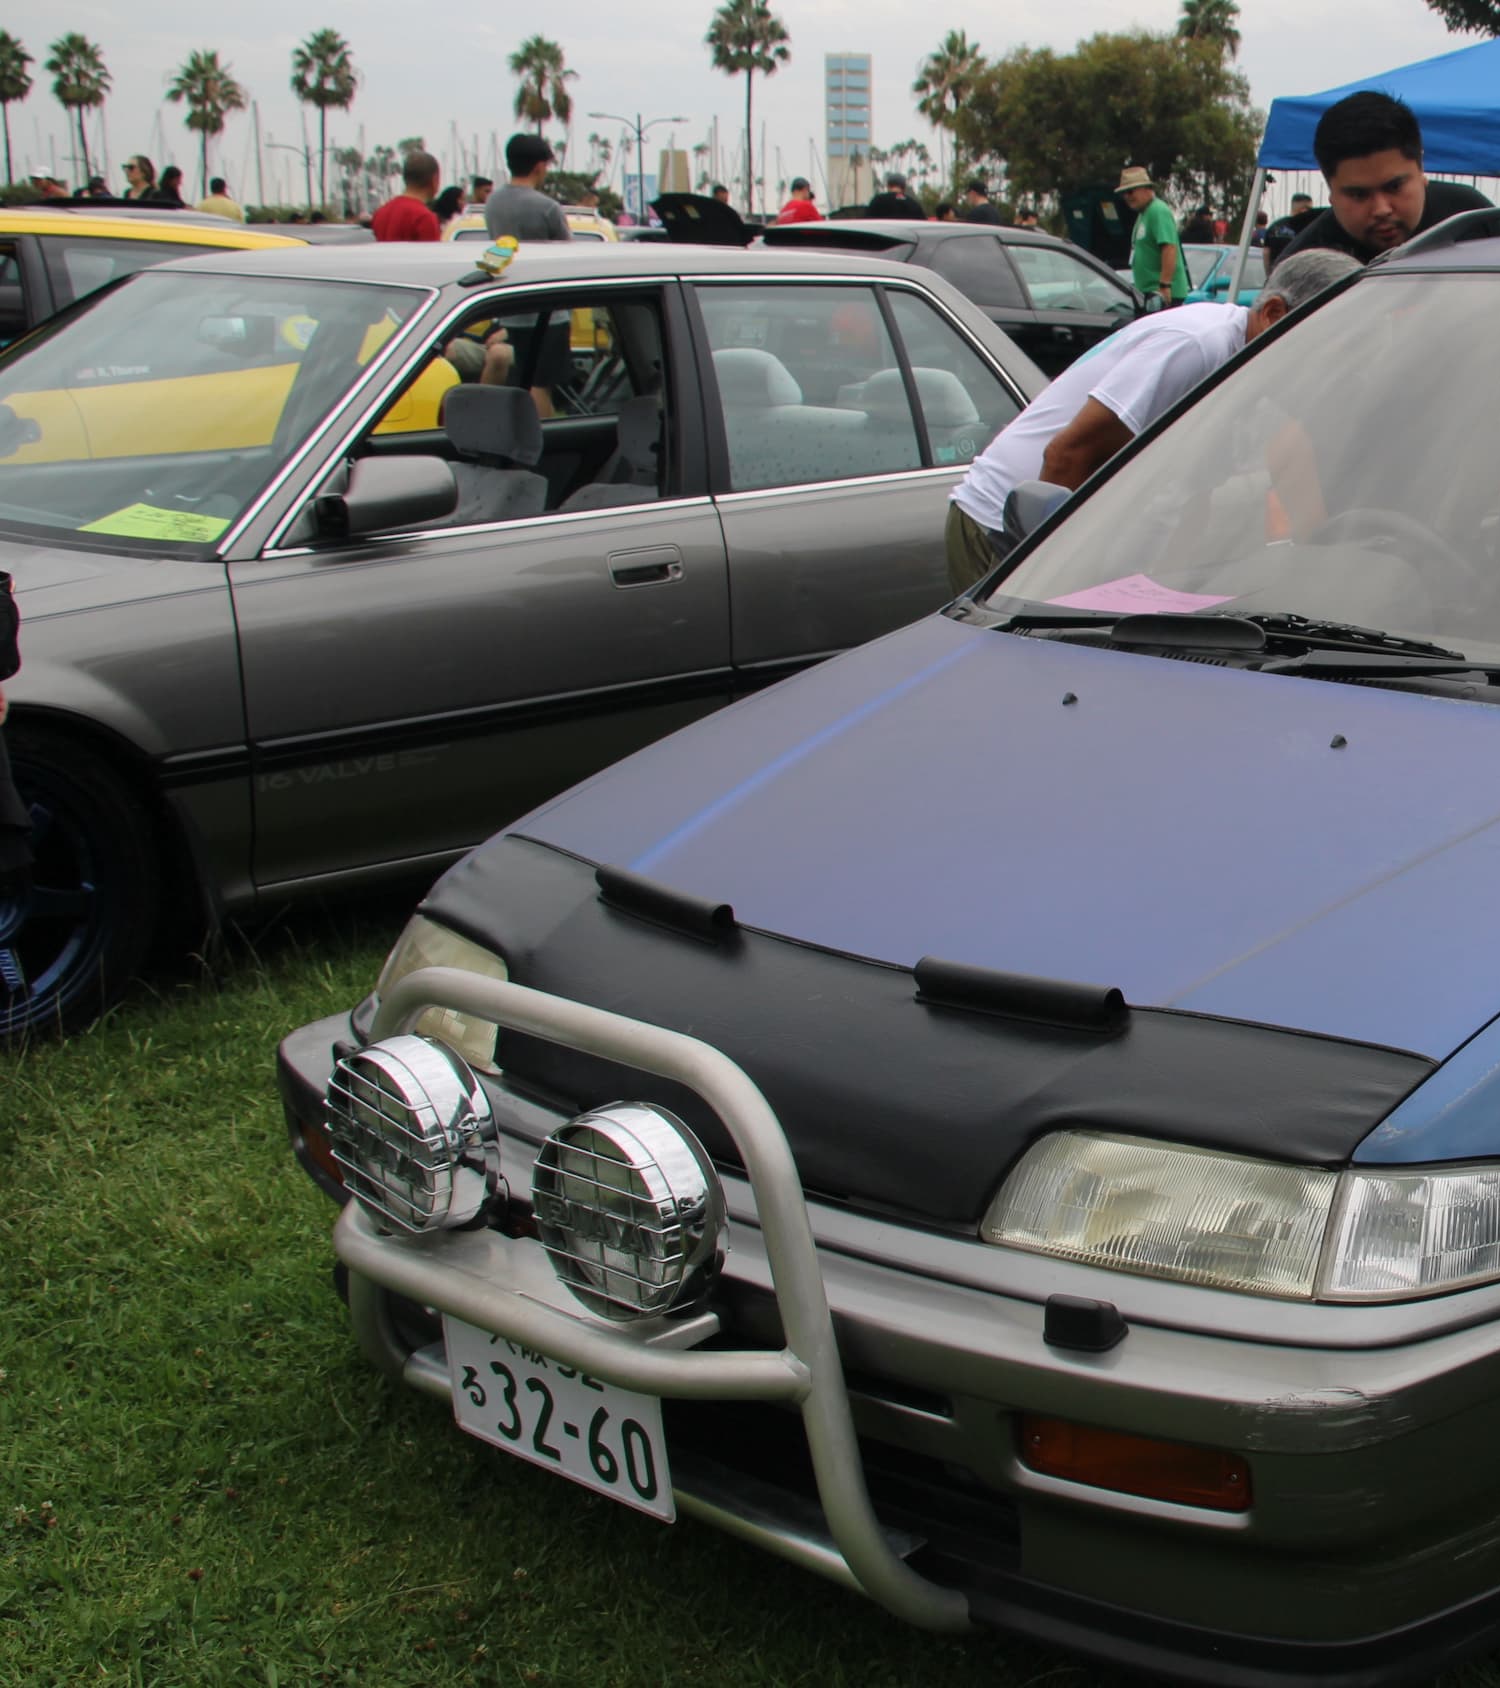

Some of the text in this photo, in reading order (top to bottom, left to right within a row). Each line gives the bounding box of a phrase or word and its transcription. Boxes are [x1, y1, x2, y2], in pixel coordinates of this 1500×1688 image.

[257, 774, 293, 793] 16
[296, 754, 394, 785] VALVE
[490, 1361, 658, 1501] 32-60
